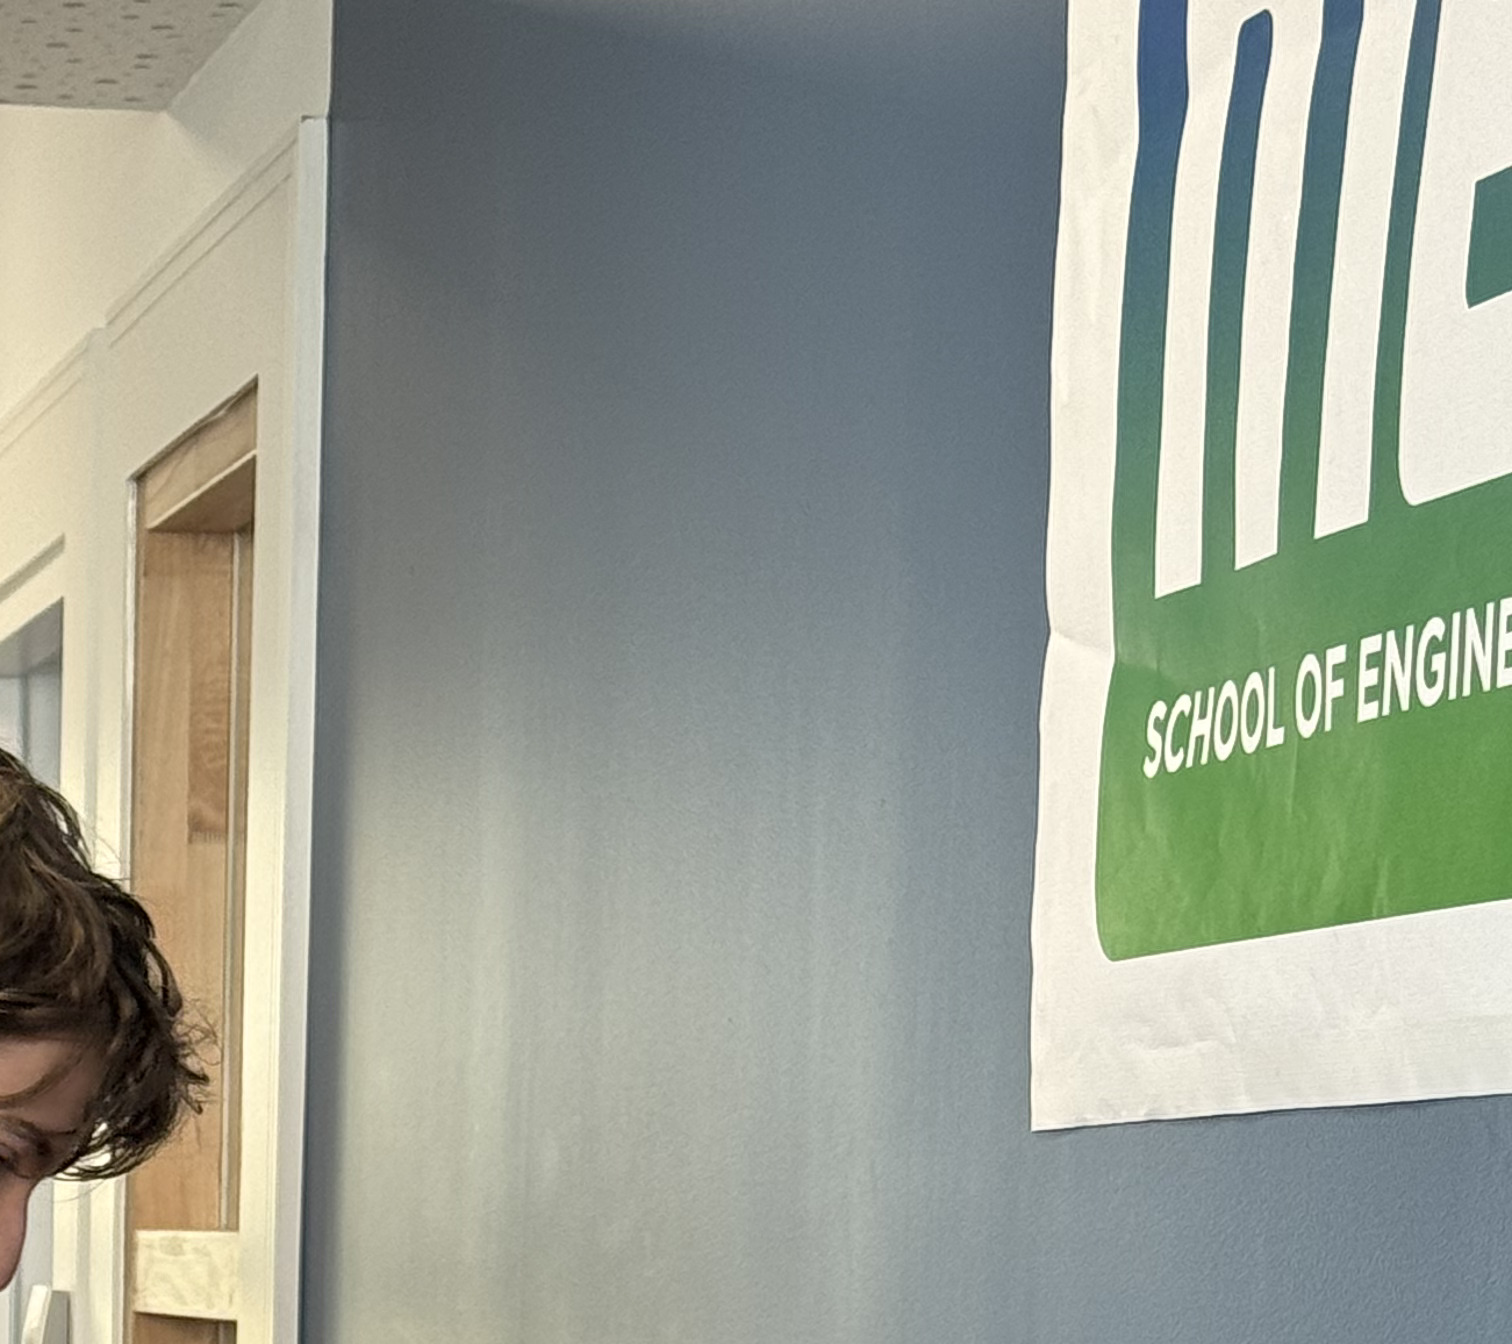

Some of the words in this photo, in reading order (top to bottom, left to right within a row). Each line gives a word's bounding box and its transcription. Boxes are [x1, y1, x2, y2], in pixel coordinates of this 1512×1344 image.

[1143, 666, 1285, 779] SCHOOL
[1295, 644, 1347, 739] OF
[1357, 597, 1512, 723] ENGINE
